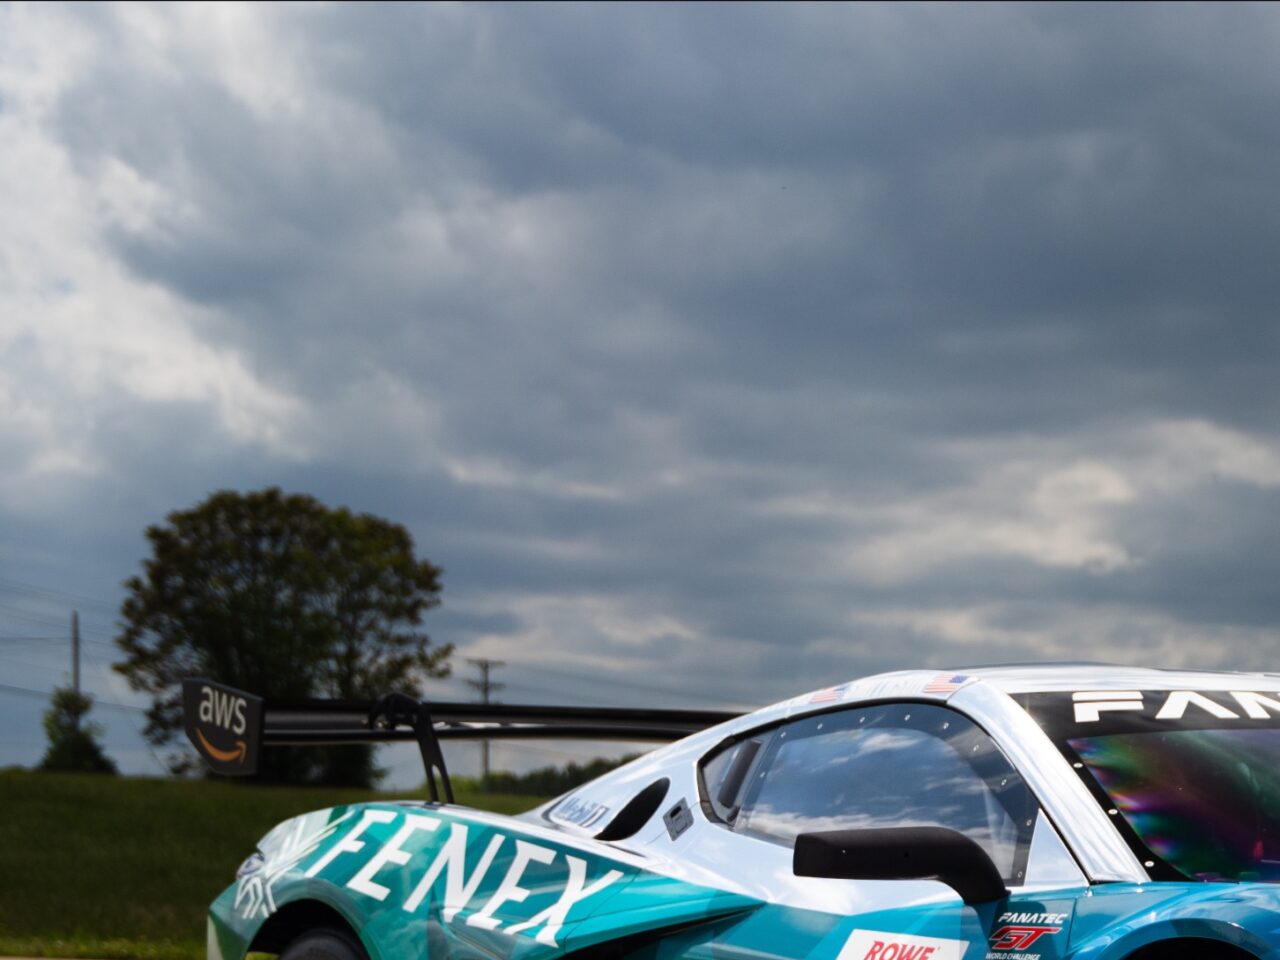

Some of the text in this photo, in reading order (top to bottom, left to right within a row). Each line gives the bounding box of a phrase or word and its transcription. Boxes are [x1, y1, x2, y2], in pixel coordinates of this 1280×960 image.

[200, 686, 247, 735] aws
[304, 809, 624, 947] FENEX
[998, 912, 1068, 924] FANATEC
[989, 925, 1062, 951] GT
[986, 952, 1041, 960] WORLD CHALLENGE
